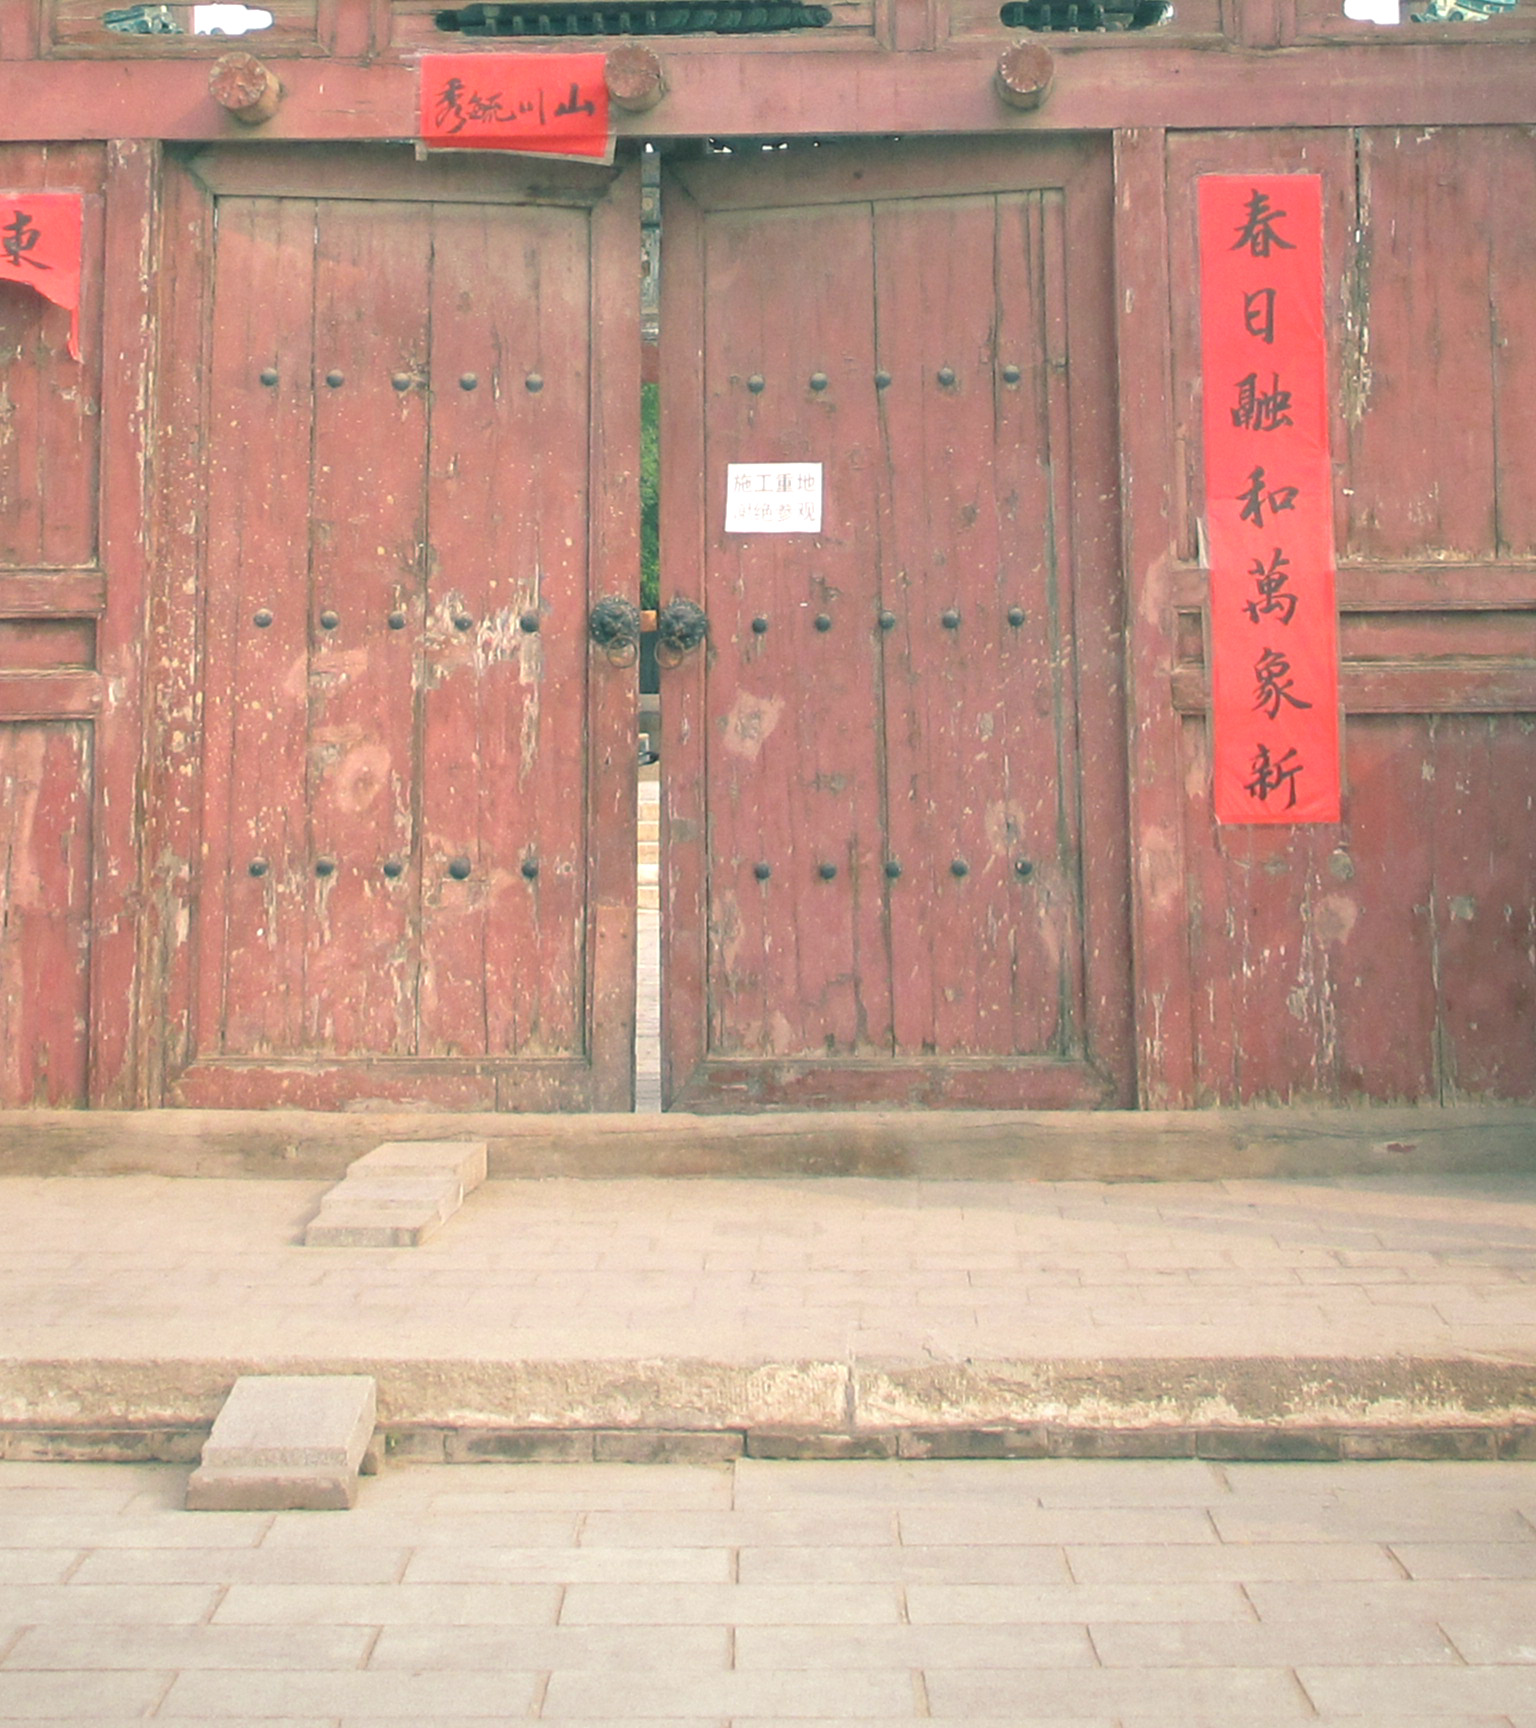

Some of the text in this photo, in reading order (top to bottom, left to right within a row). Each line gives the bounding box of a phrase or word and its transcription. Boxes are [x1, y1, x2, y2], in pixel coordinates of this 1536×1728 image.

[733, 472, 816, 493] 施工重地
[1229, 187, 1313, 810] 春日融和萬象新
